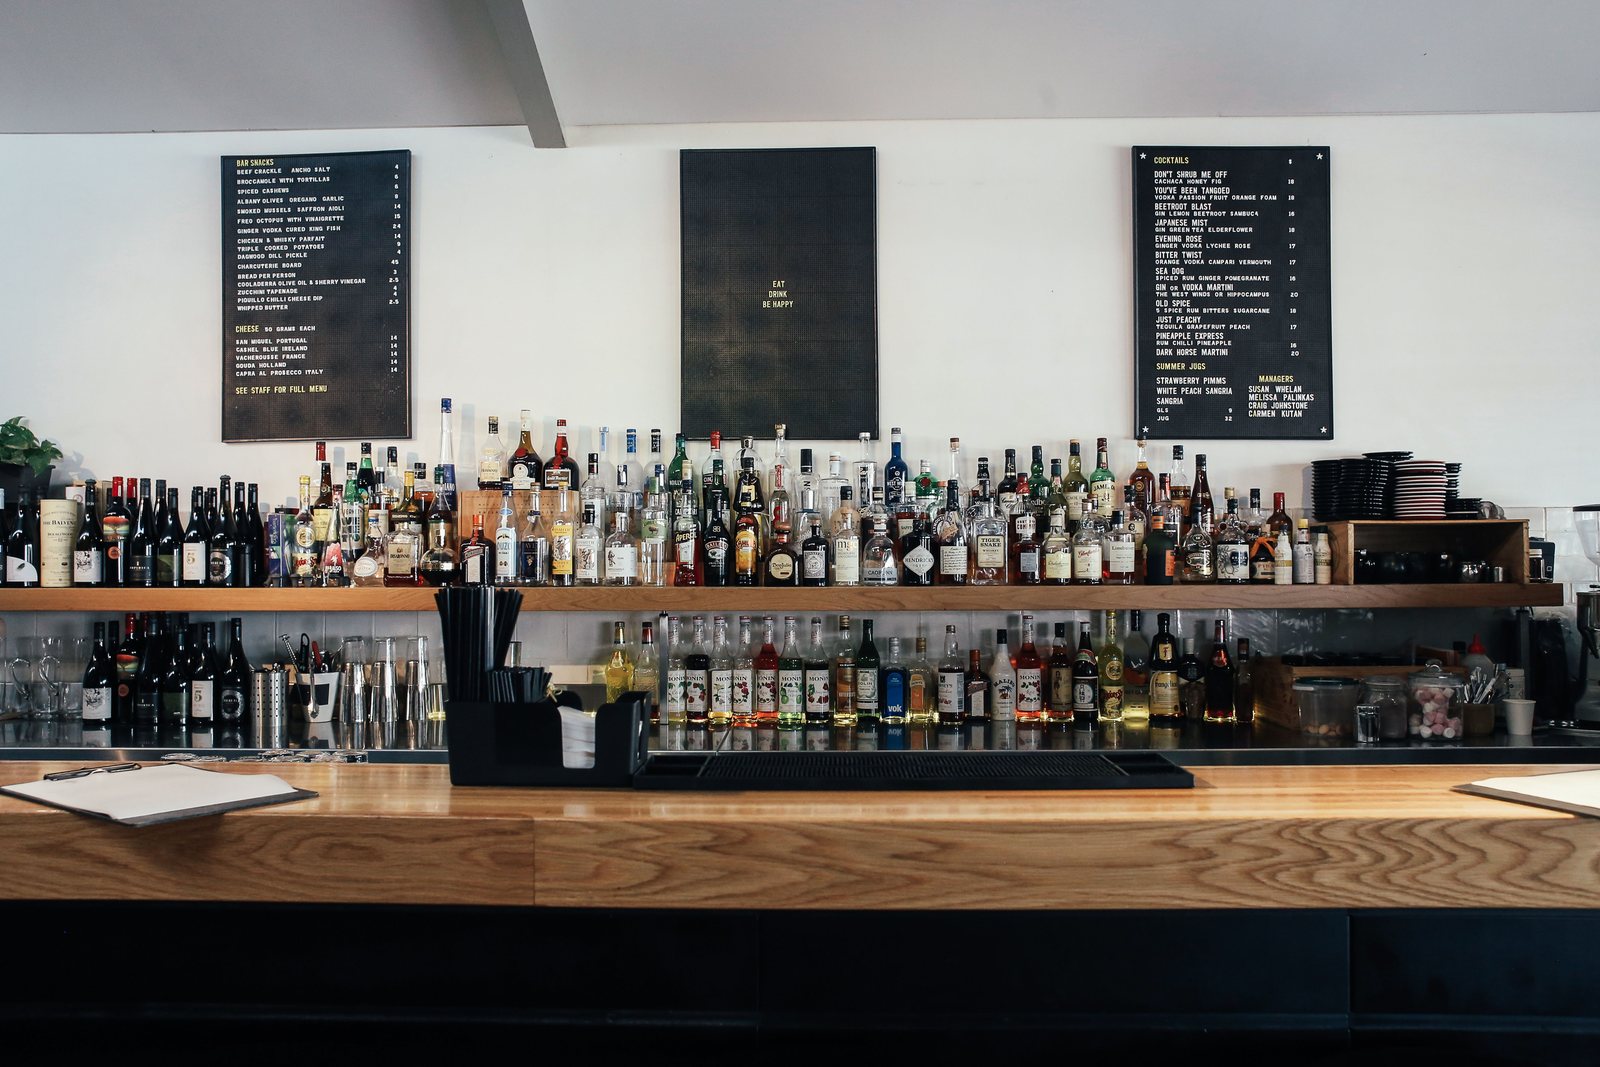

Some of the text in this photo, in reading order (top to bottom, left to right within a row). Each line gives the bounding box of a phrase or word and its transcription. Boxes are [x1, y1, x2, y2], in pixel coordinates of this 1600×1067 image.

[250, 158, 274, 166] SNACKS
[235, 325, 259, 333] CHEESE
[194, 690, 202, 702] 5
[888, 704, 902, 713] vok
